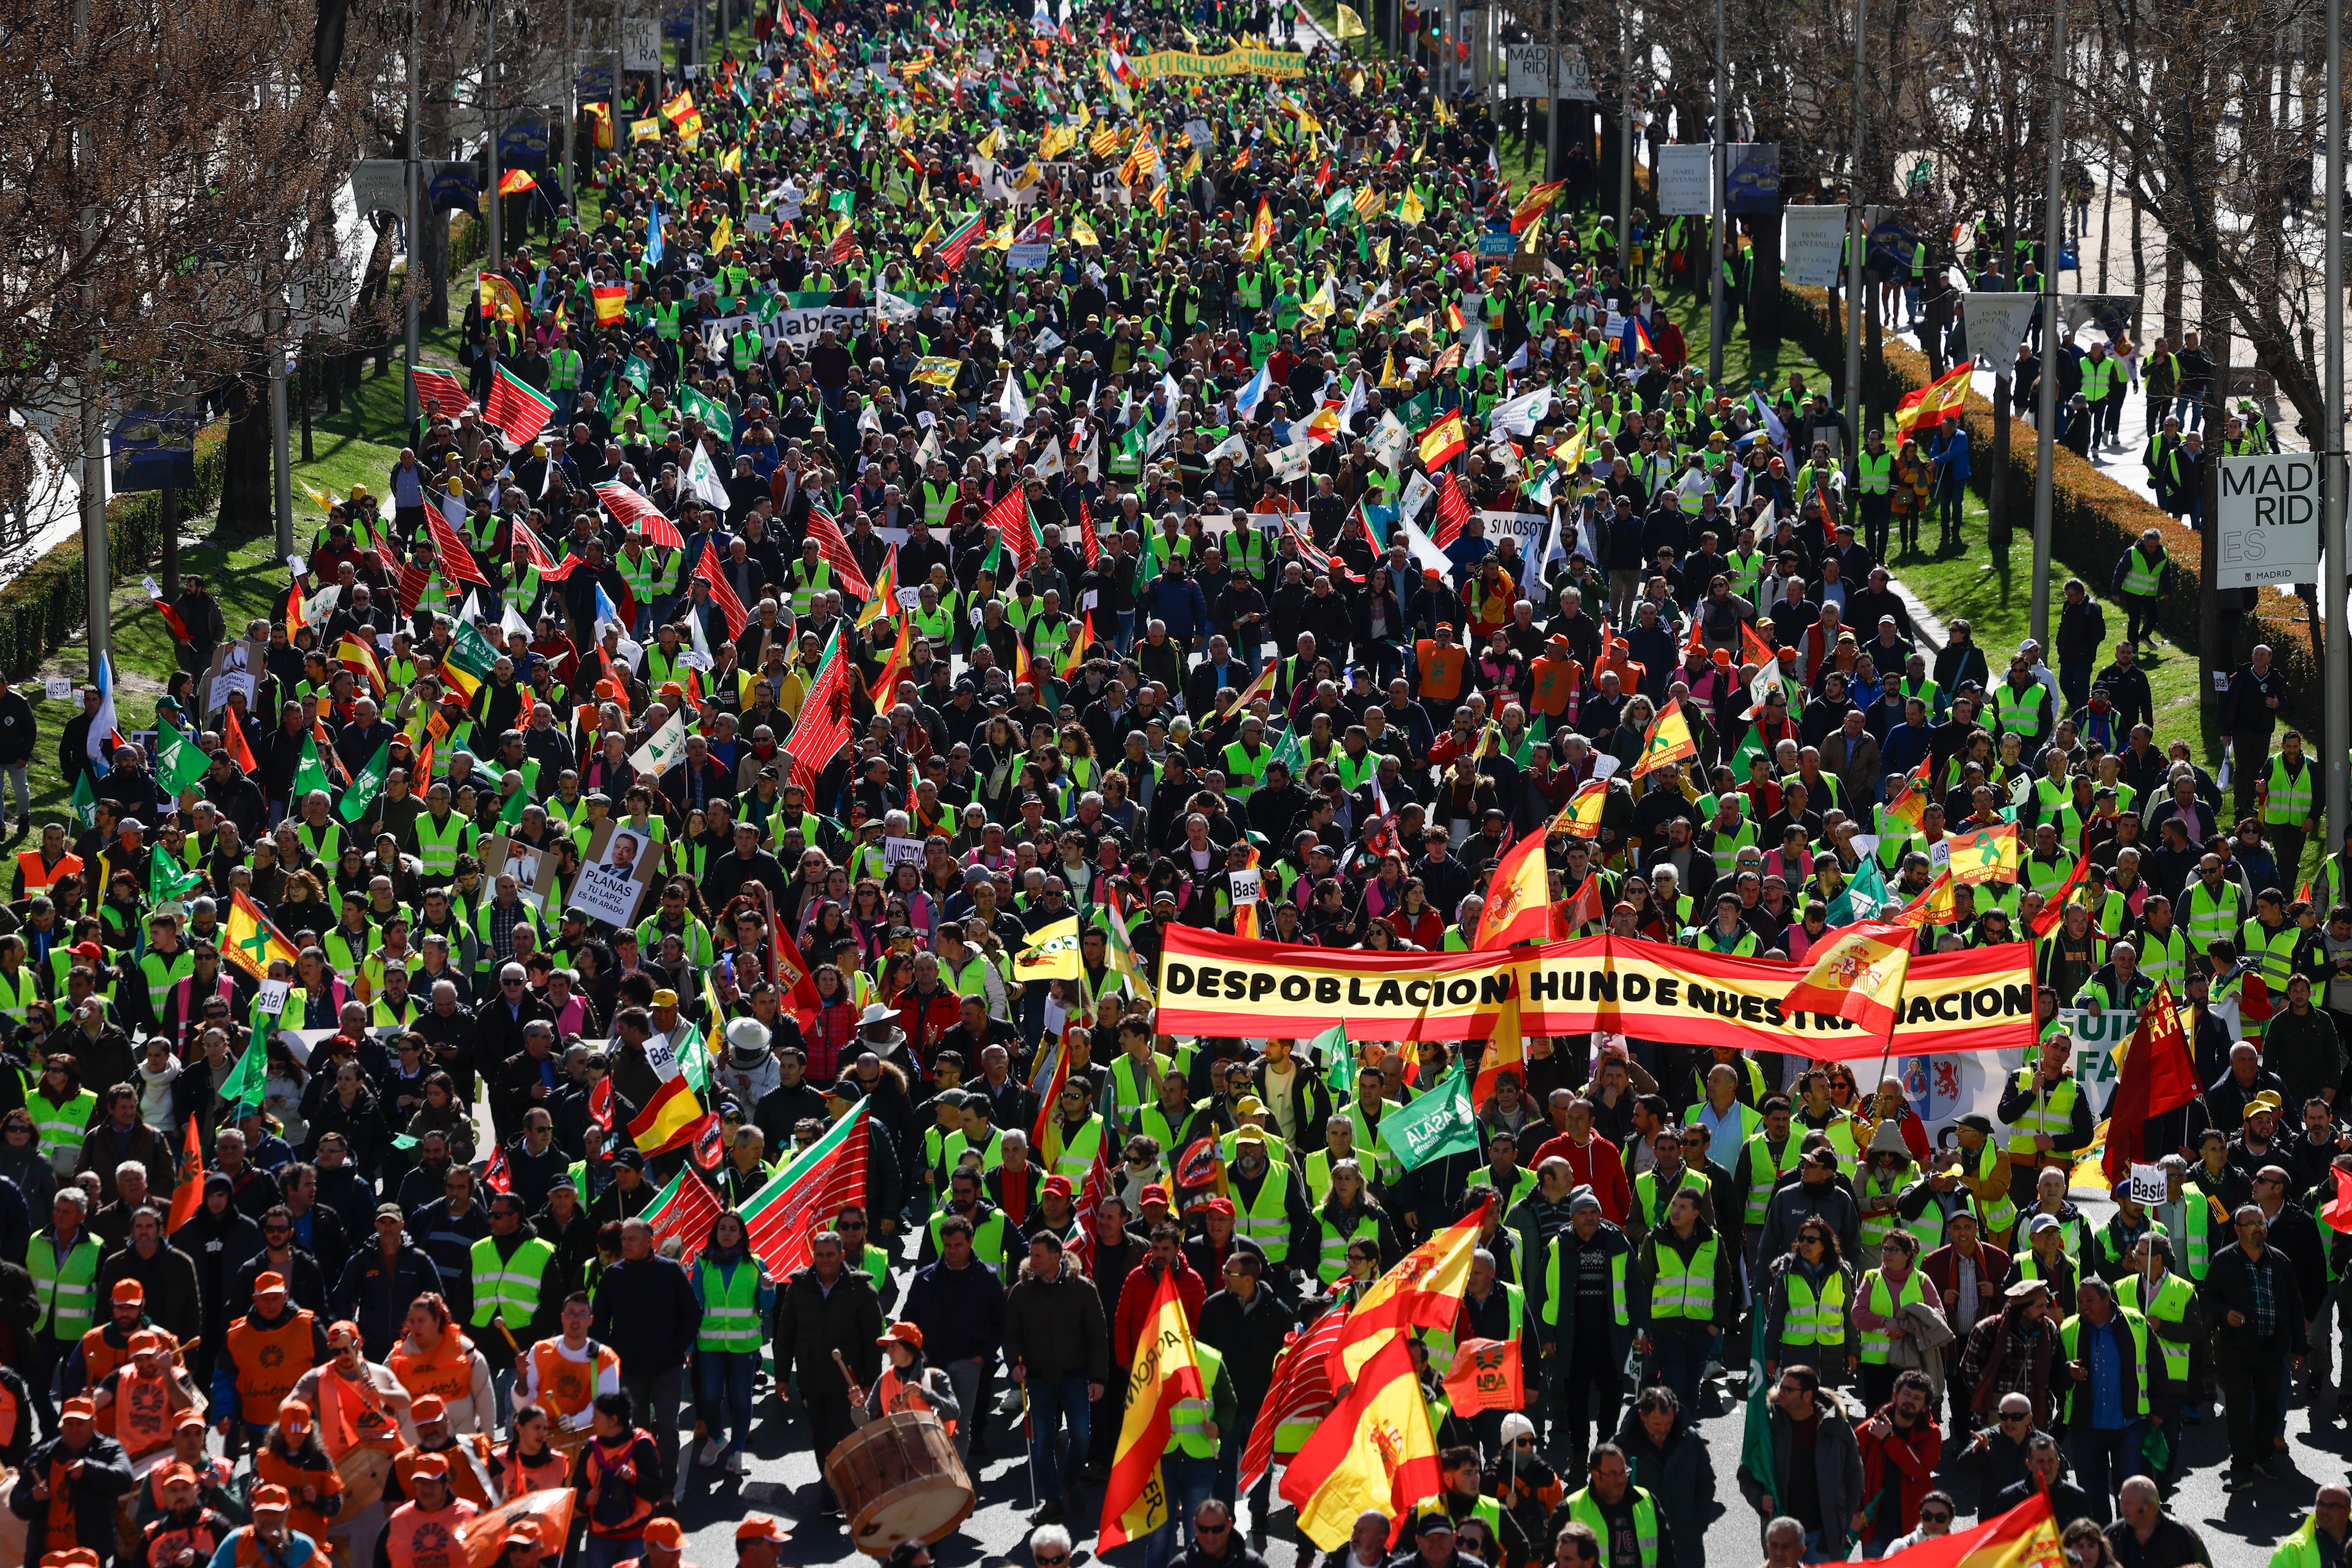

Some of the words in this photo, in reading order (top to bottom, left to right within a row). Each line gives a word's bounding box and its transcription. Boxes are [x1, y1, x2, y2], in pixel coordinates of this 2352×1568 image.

[639, 49, 659, 61] RA
[1176, 56, 1227, 74] RELEVO
[1230, 51, 1242, 63] DE
[1248, 52, 1304, 69] HUESCA
[1510, 48, 1546, 61] MAD
[1523, 61, 1546, 74] RID
[1788, 240, 1840, 249] QUINTANILLA
[1982, 308, 2010, 321] ISABEL
[703, 309, 869, 342] Funlabrad
[1968, 318, 2020, 340] QUINTANILLA
[1985, 350, 2000, 368] MADRID
[2223, 463, 2313, 497] MAD
[2256, 494, 2313, 526] RID
[1491, 519, 1502, 533] SI
[1503, 519, 1545, 536] NOSOT
[2224, 529, 2266, 563] ES
[2257, 569, 2292, 580] MADRID
[471, 642, 496, 665] ASAJ
[684, 654, 704, 668] ¡JUSTICIA!
[48, 682, 70, 694] ¡JUSTICIA!
[225, 675, 245, 683] CAMPO
[663, 732, 679, 752] ASAJA
[1933, 844, 1948, 862] ¡JUST
[585, 869, 632, 897] PLANAS
[577, 890, 587, 900] ES
[589, 895, 599, 904] MI
[601, 899, 624, 915] ARADO
[588, 883, 598, 893] TU
[600, 886, 623, 906] LAPIZ
[1167, 963, 1510, 1007] DESPOBLACION
[1530, 970, 1678, 1006] HUNDE
[2132, 1177, 2167, 1199] Basta!
[1477, 1373, 1507, 1389] UPA
